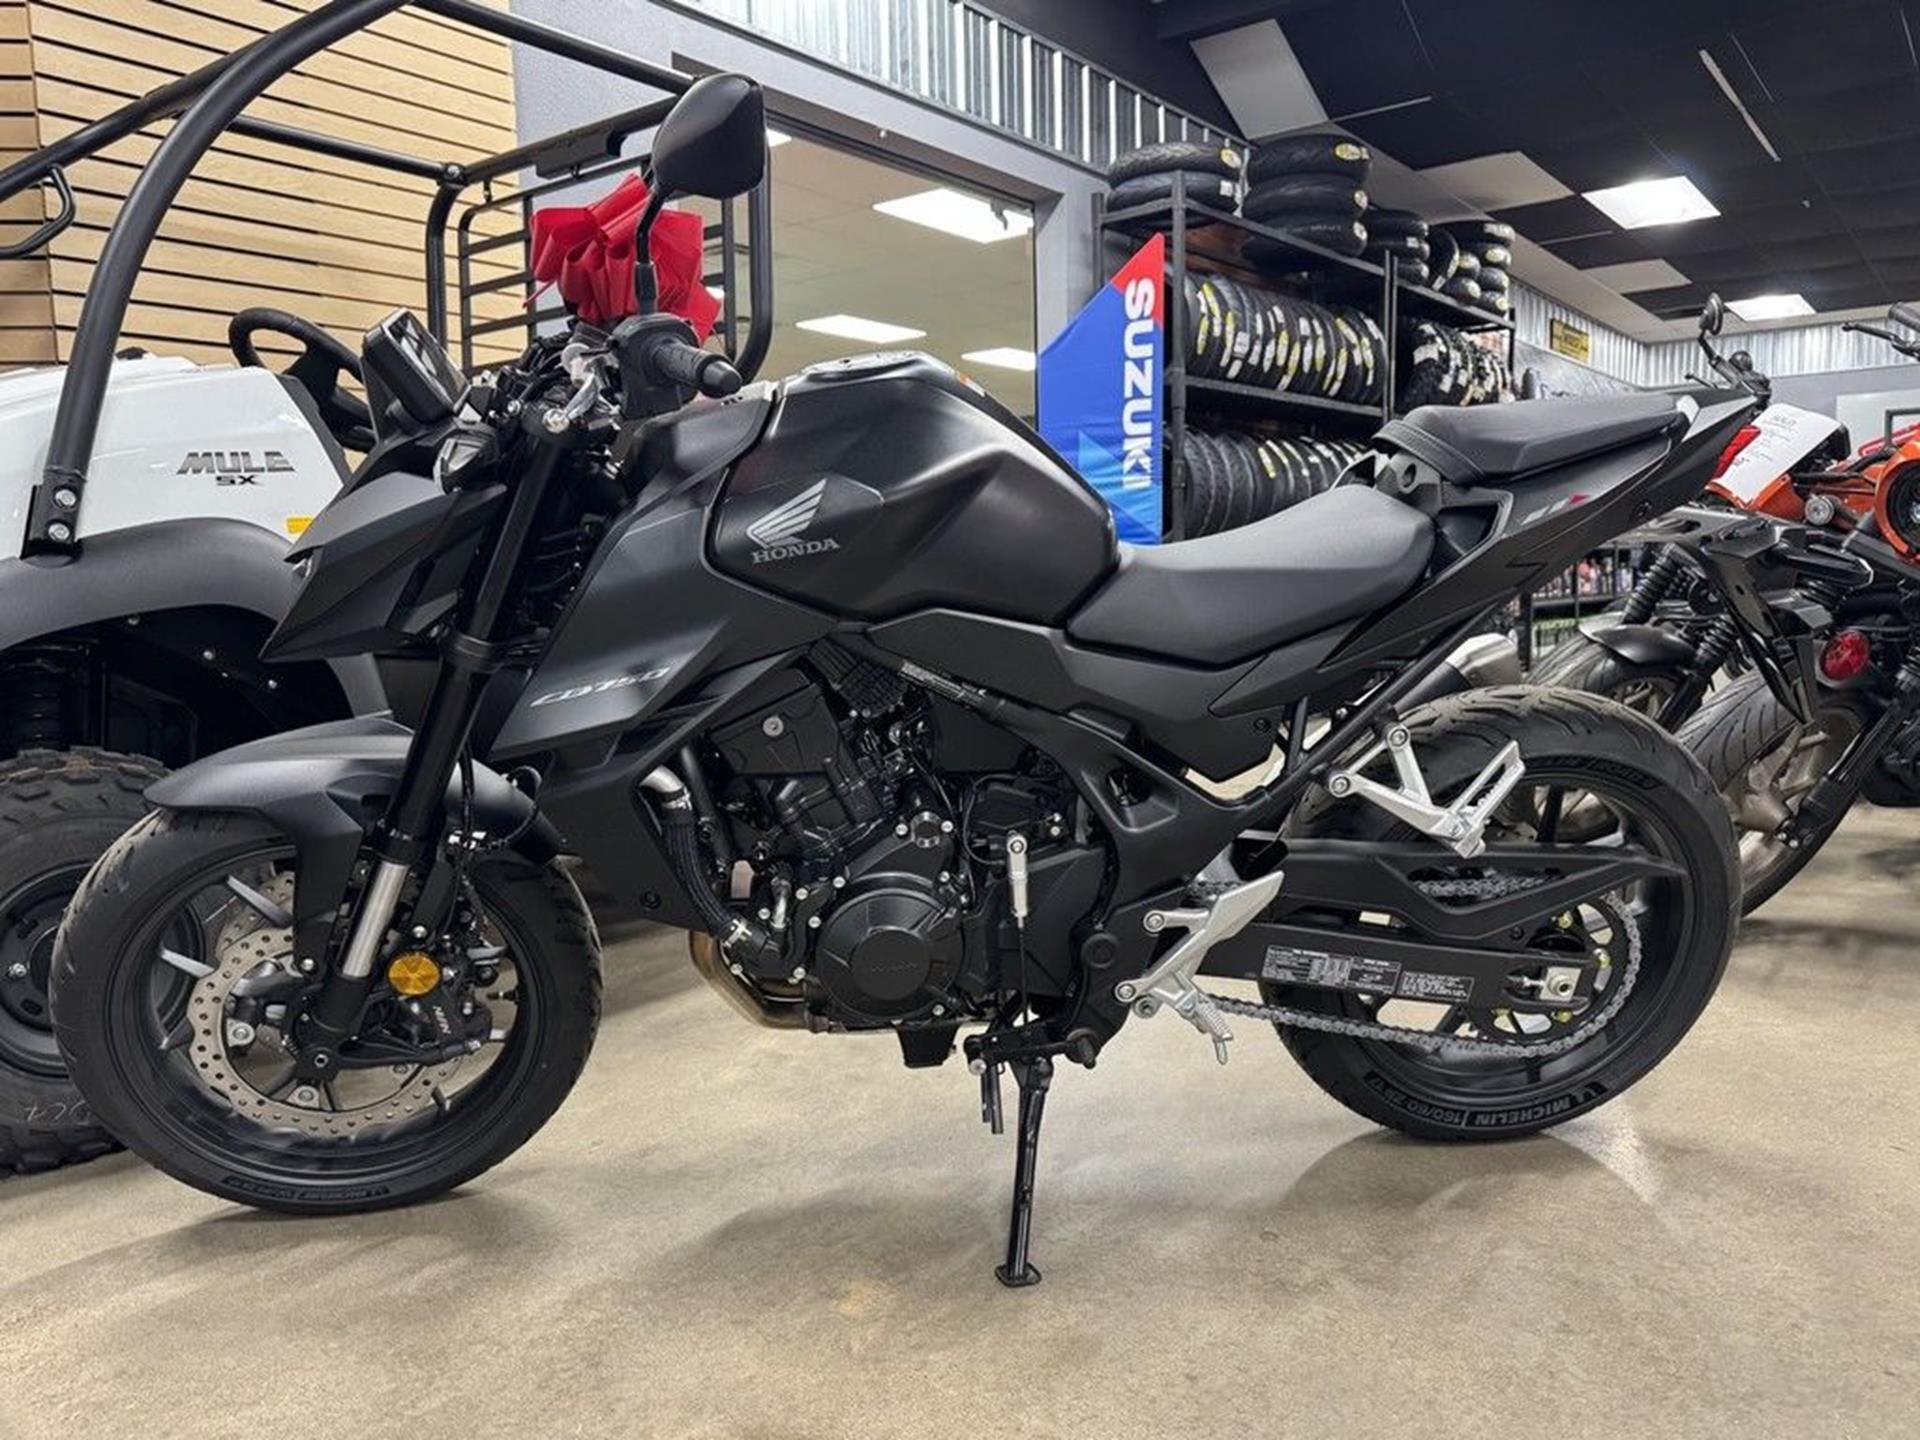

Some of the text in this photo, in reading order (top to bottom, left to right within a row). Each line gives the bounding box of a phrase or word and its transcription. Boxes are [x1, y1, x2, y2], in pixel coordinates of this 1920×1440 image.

[1122, 278, 1155, 489] SUZUKI
[176, 451, 295, 474] MULE
[751, 538, 840, 564] HONDA
[1474, 1096, 1571, 1126] MICHELIN
